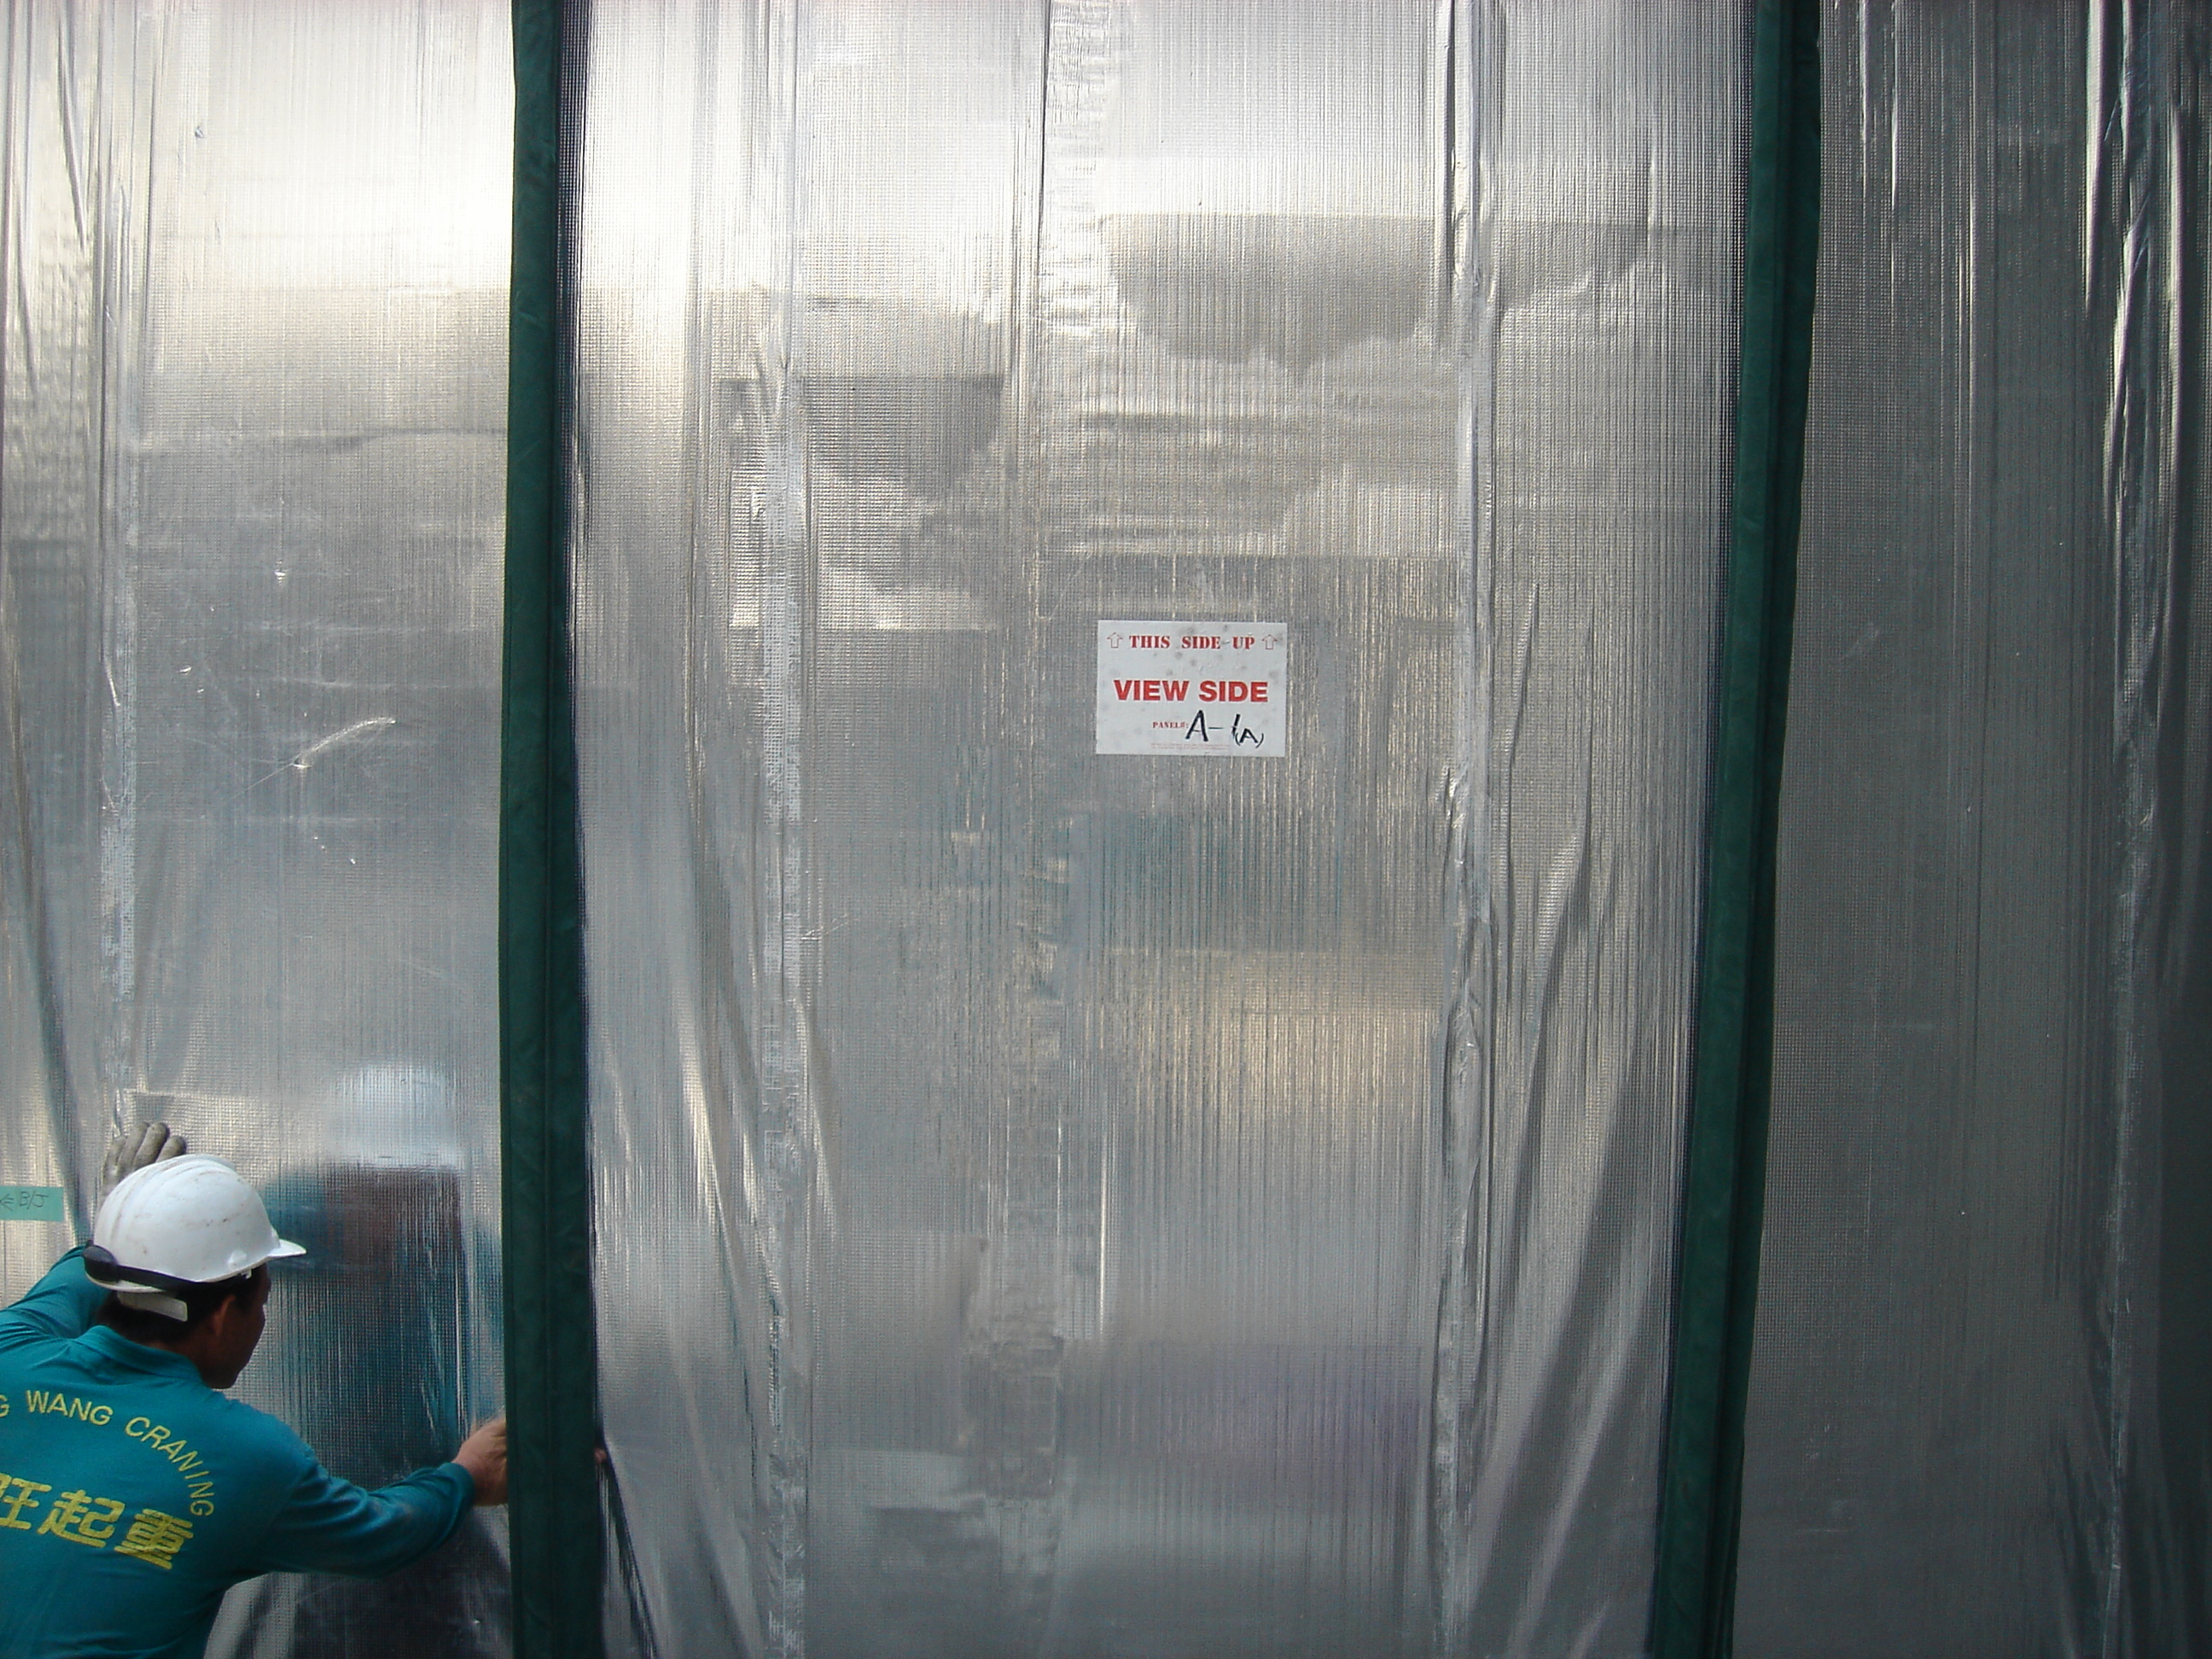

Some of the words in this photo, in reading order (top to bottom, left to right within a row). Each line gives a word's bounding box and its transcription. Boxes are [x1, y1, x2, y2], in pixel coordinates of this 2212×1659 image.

[1129, 635, 1170, 649] THIS
[1181, 636, 1221, 649] SIDE
[1232, 636, 1255, 649] UP
[1113, 679, 1190, 701] VIEW
[1198, 680, 1269, 702] SIDE
[26, 1389, 114, 1426] WANG
[125, 1417, 215, 1516] CRANING
